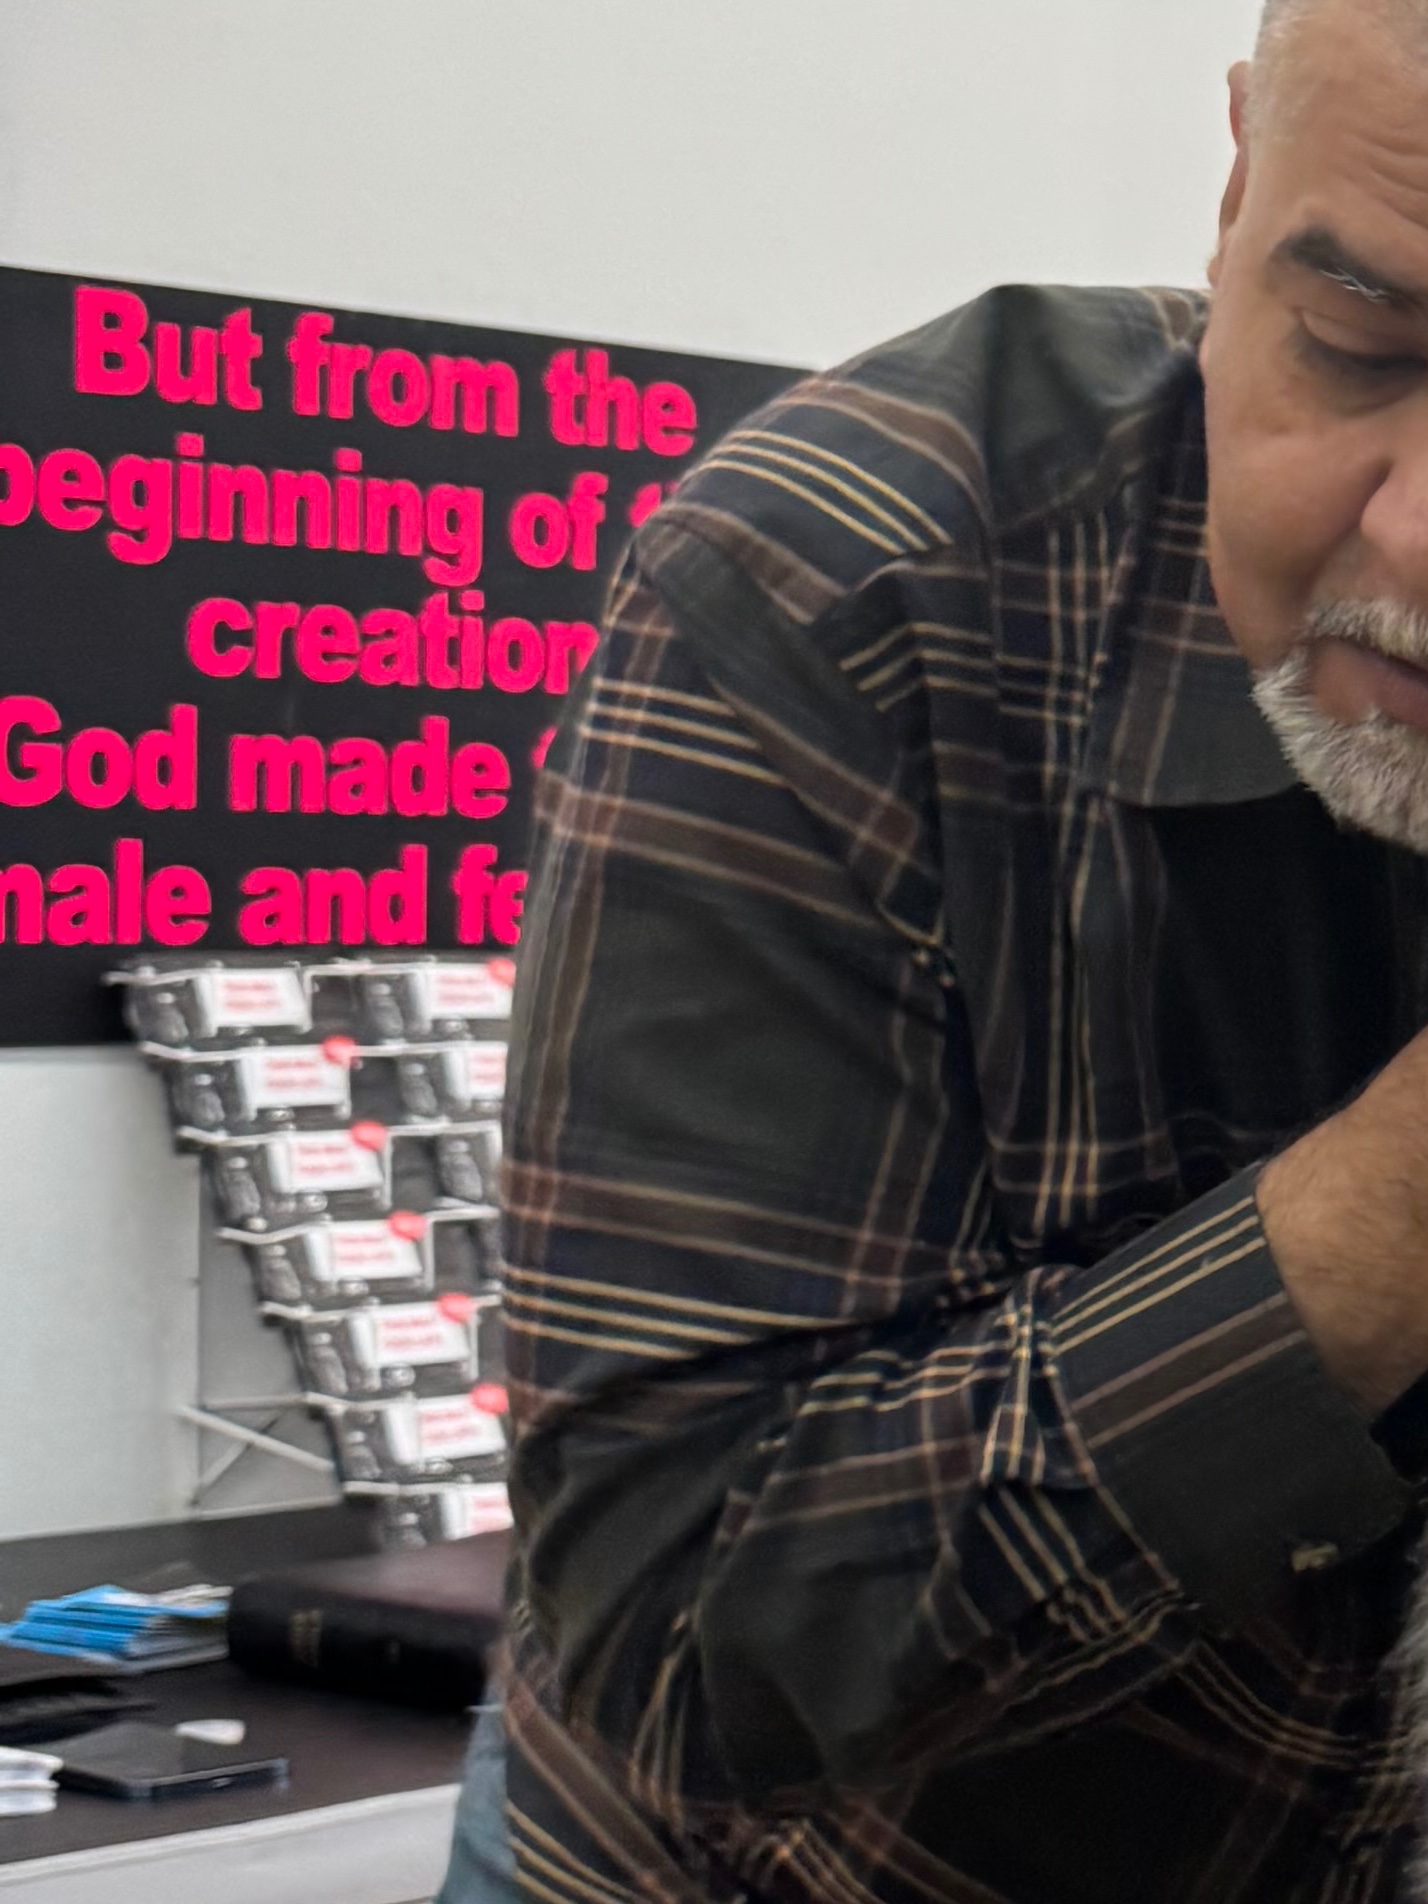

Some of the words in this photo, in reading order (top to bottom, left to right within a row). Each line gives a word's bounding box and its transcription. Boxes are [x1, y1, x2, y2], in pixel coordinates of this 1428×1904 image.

[74, 285, 262, 411] But
[287, 312, 519, 437] from
[544, 348, 698, 456] the
[508, 471, 608, 571] of
[186, 589, 599, 695] creation
[0, 696, 198, 810] God
[229, 715, 510, 819] made
[238, 843, 428, 946] and
